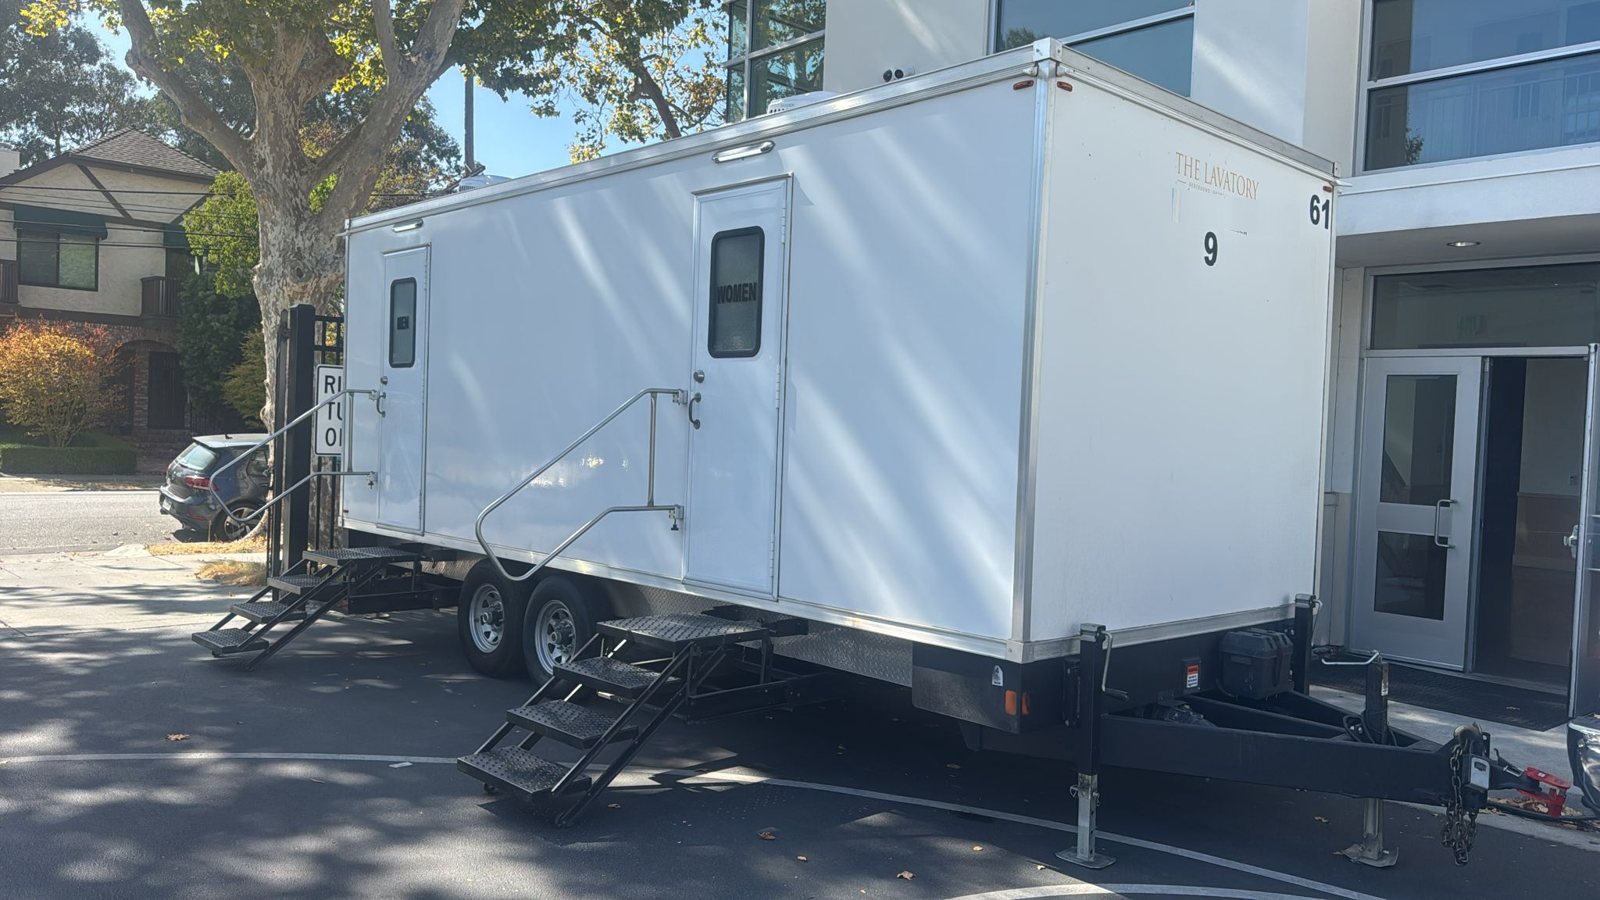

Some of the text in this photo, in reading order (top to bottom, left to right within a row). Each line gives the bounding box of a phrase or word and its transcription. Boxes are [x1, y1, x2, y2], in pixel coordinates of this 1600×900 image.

[1176, 151, 1200, 181] THE
[1204, 162, 1259, 200] LAVATORY
[1309, 194, 1330, 230] 61
[1203, 231, 1218, 266] 9
[716, 282, 757, 304] WOMEN
